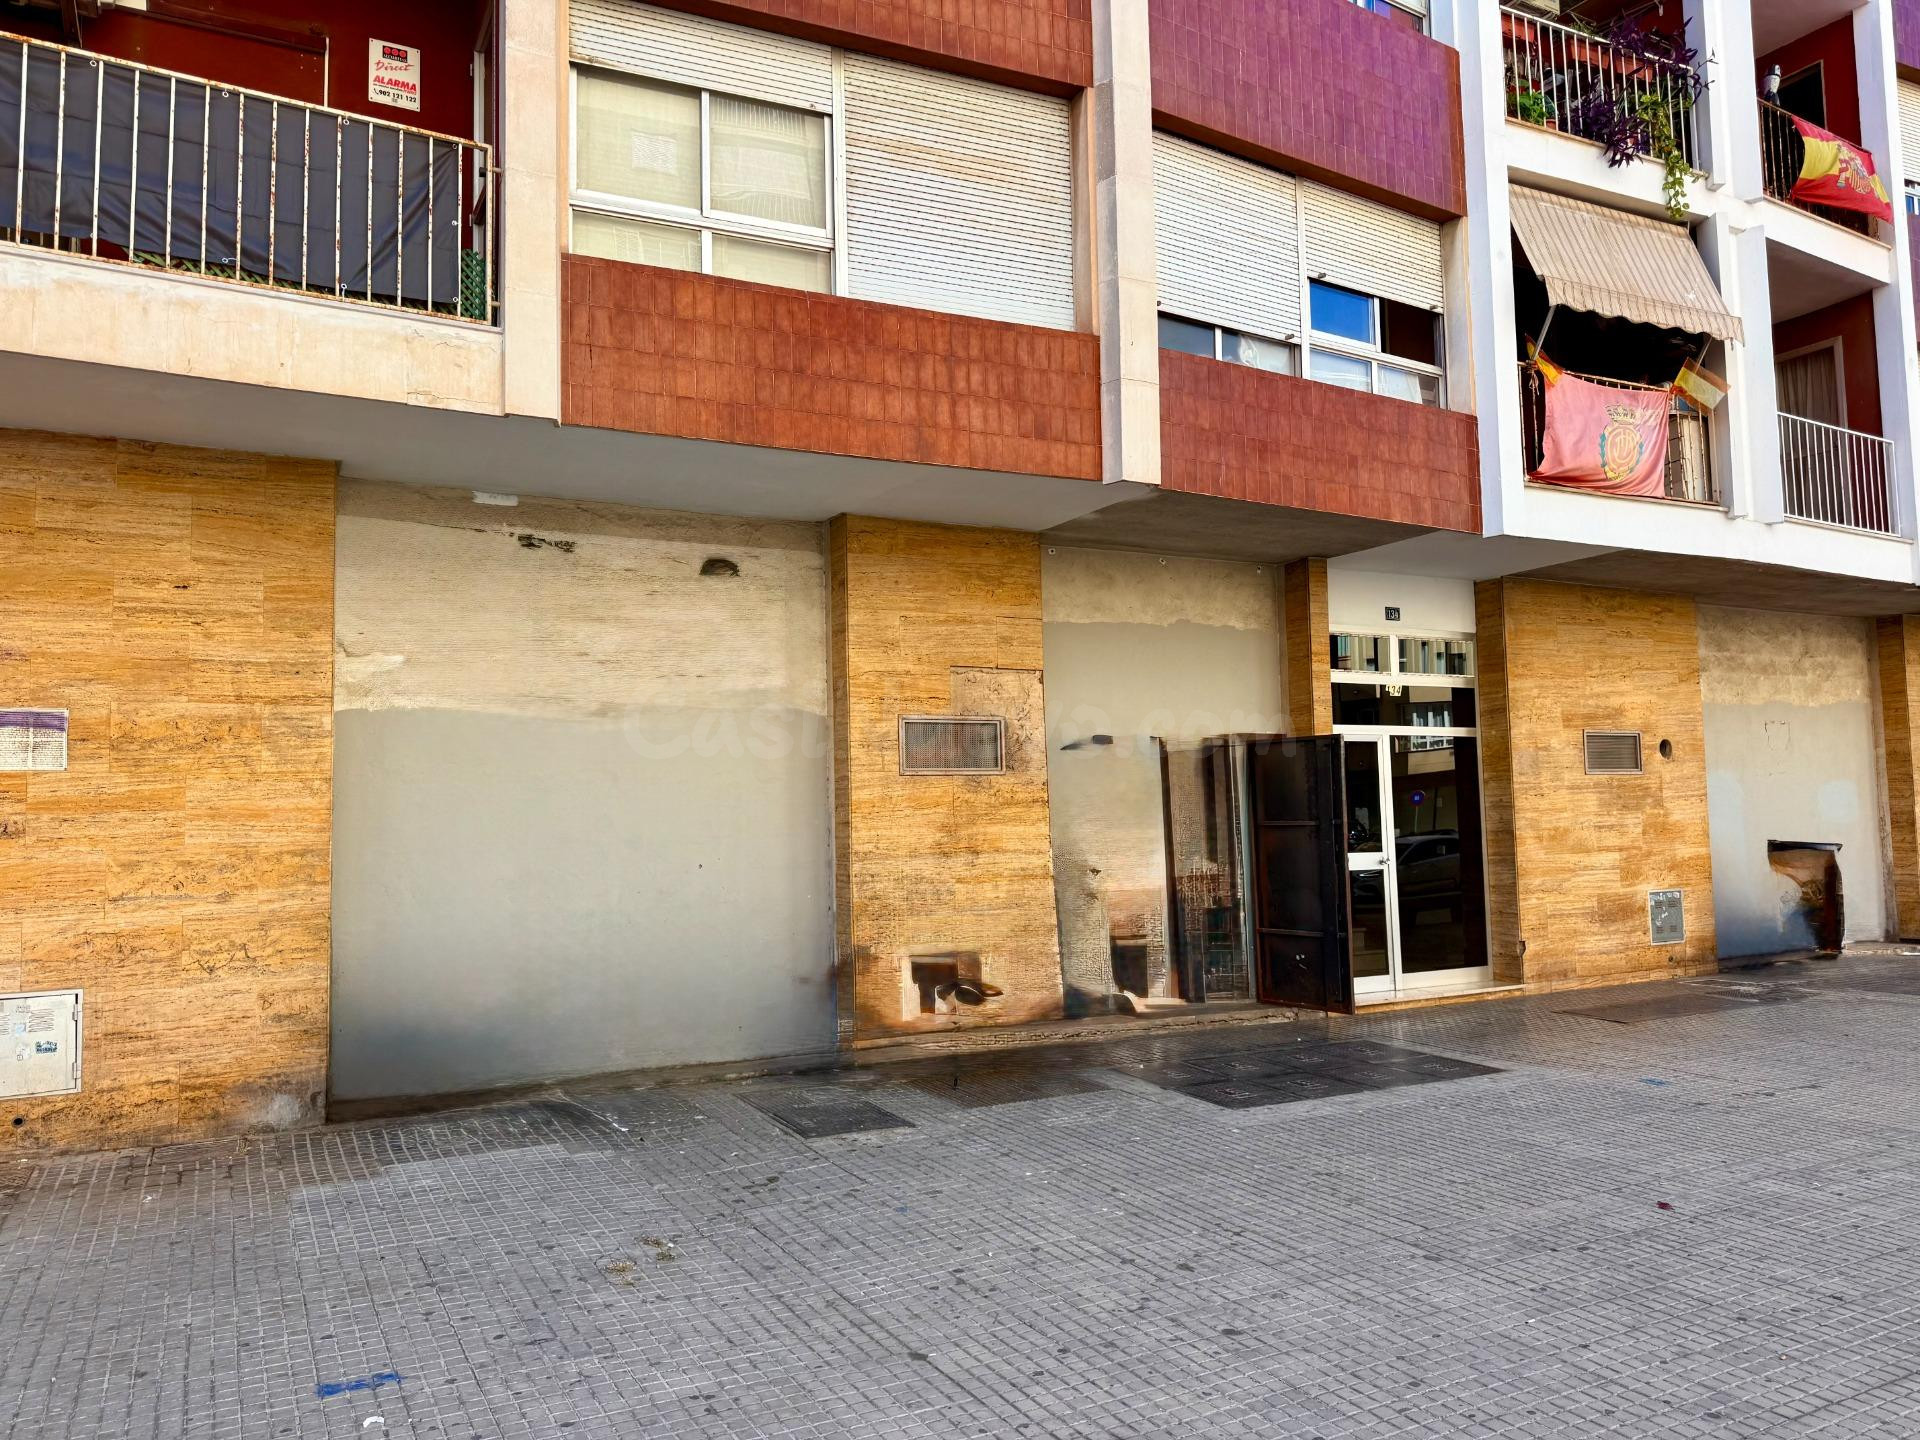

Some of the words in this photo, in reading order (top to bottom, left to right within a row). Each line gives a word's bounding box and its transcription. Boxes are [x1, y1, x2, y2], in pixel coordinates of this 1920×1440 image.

[375, 60, 414, 70] Direct
[373, 75, 416, 91] ALARMA
[405, 95, 417, 103] 122
